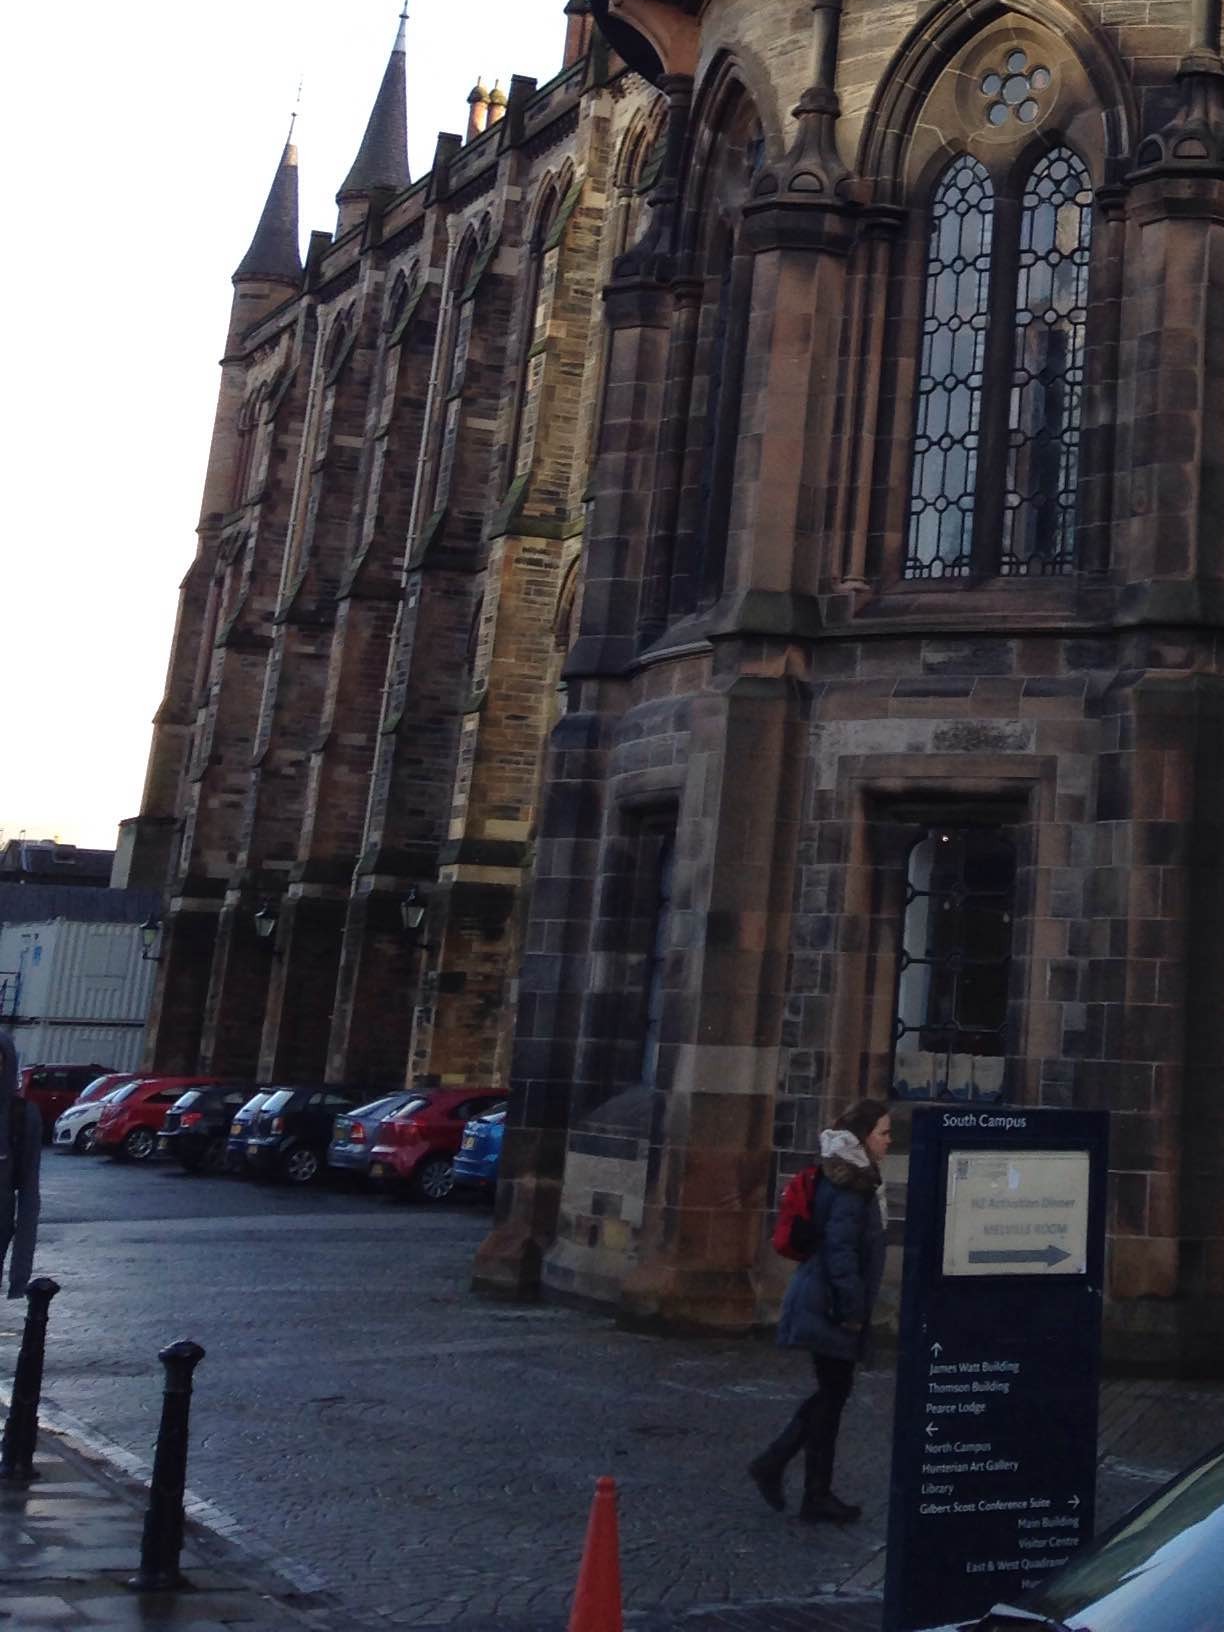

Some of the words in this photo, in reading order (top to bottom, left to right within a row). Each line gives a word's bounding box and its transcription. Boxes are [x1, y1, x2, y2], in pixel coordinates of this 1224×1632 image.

[942, 1113, 977, 1127] South
[978, 1114, 1027, 1130] Campus
[929, 1362, 958, 1376] James
[959, 1362, 981, 1373] Watt
[982, 1360, 1021, 1374] Building
[928, 1382, 971, 1393] Thomson
[971, 1380, 1010, 1394] Building
[926, 1403, 957, 1414] Pearce
[958, 1401, 986, 1415] Lodge
[924, 1443, 953, 1454] North
[953, 1441, 992, 1455] Campus
[922, 1464, 969, 1474] Hunterian
[970, 1461, 985, 1471] Art
[985, 1459, 1019, 1472] Gallery
[921, 1482, 954, 1496] Library
[920, 1503, 952, 1514] Gilbert
[952, 1501, 977, 1513] Scott
[978, 1499, 1028, 1511] Conference
[1029, 1497, 1051, 1508] Suite
[1017, 1518, 1041, 1529] Main
[1041, 1516, 1080, 1529] Building
[1018, 1537, 1048, 1549] Visitor
[1048, 1536, 1080, 1548] Centre
[966, 1561, 986, 1573] East
[996, 1559, 1020, 1571] West
